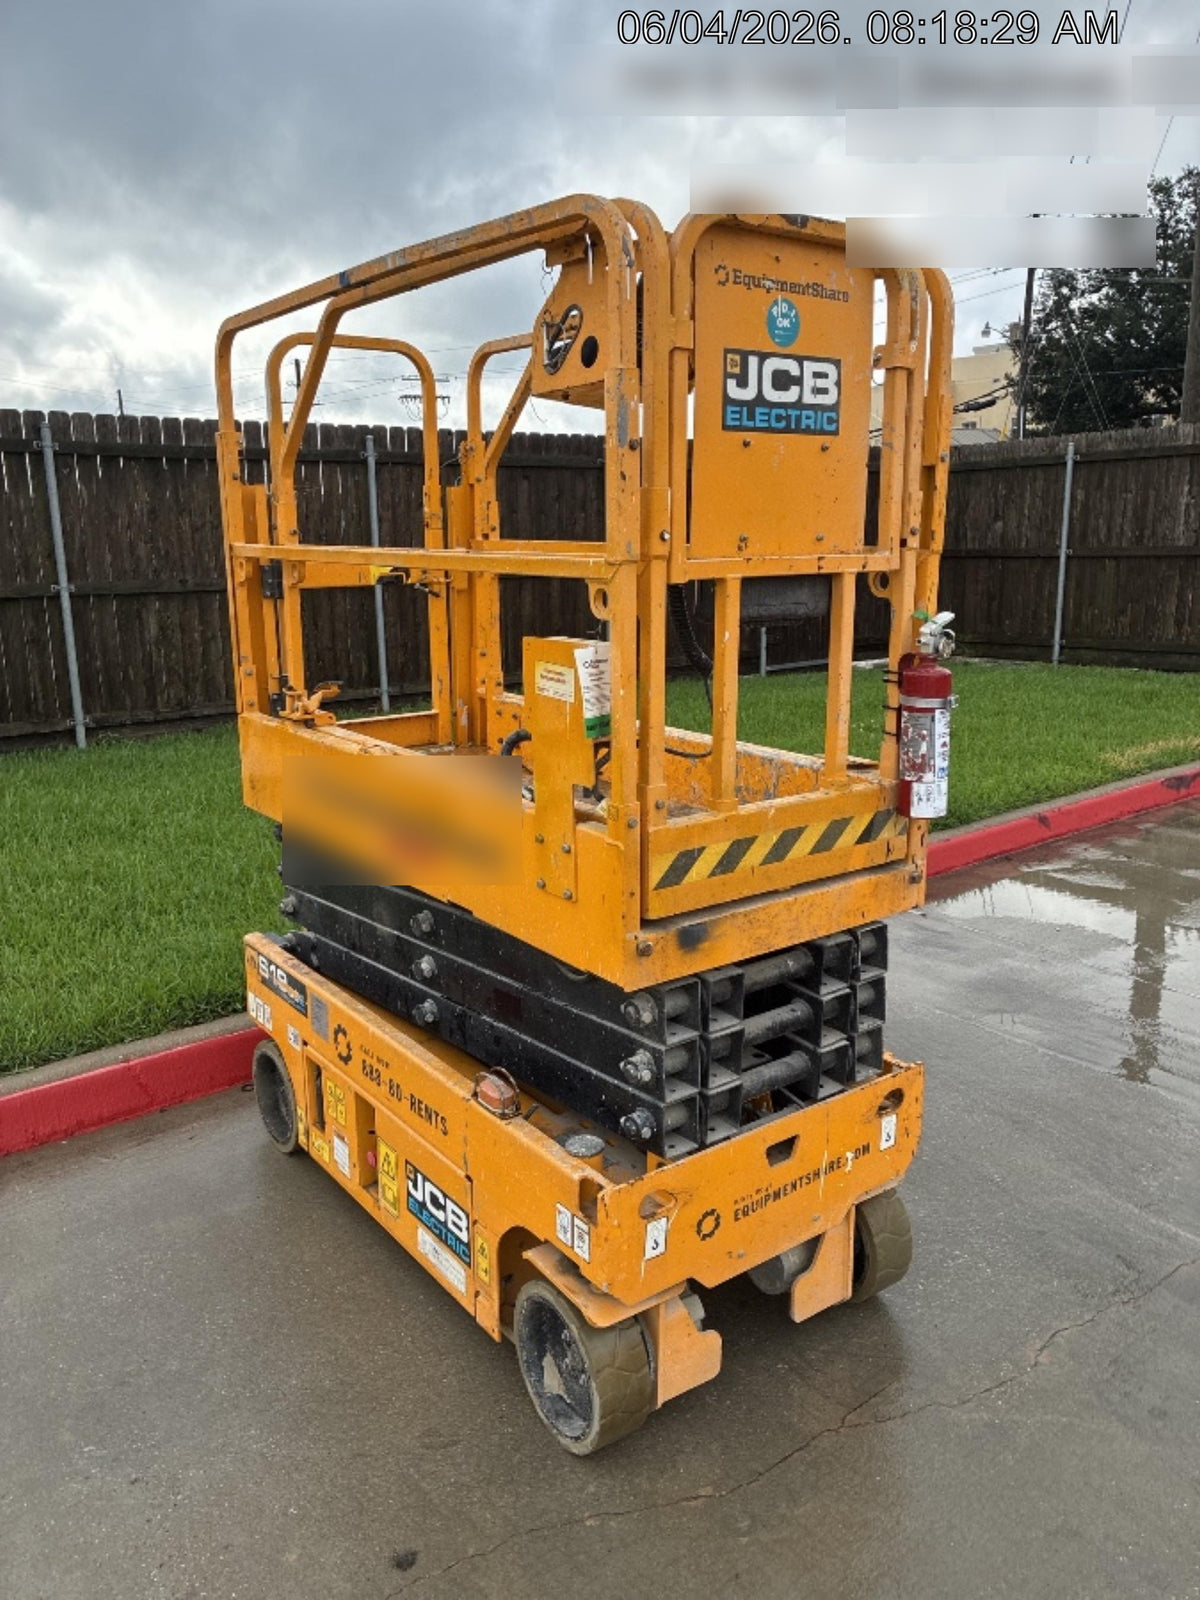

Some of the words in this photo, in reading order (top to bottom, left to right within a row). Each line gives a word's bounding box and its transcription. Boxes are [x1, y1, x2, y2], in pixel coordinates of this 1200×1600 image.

[732, 267, 850, 303] EquipmentShare
[776, 317, 791, 329] OK
[726, 355, 839, 406] JCB
[726, 405, 838, 432] ELECTRIC
[734, 1142, 870, 1222] EQUIPMENTSHRE.OM
[407, 1172, 469, 1244] JCB
[408, 1195, 470, 1264] ELECTRIC
